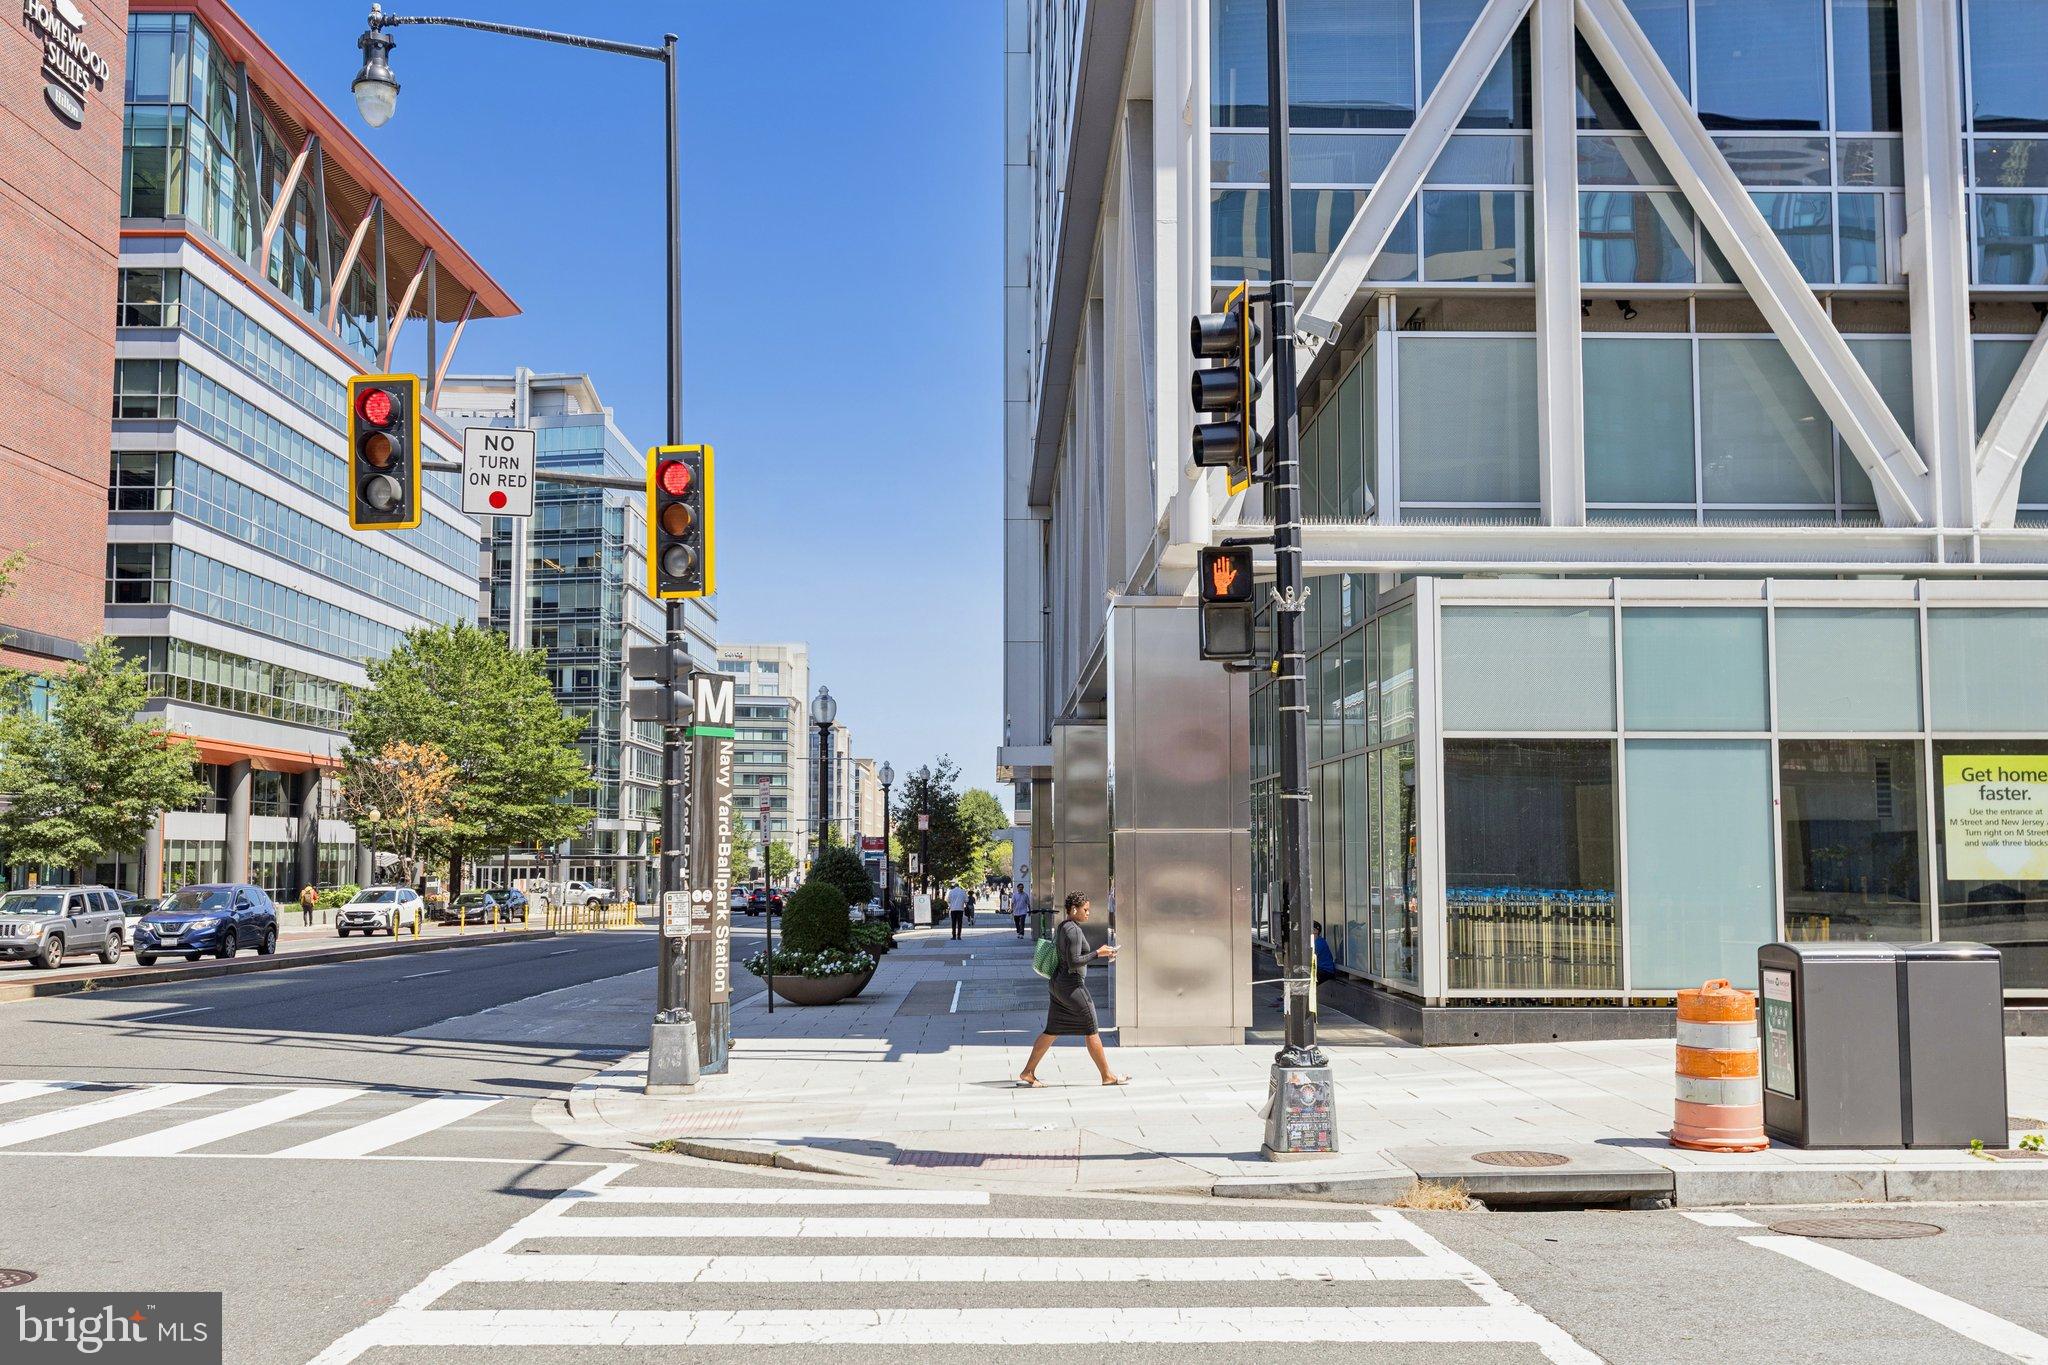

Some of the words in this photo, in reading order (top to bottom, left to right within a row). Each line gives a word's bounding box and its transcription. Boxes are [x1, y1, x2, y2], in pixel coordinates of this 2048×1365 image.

[24, 0, 109, 81] HOMEWOOD
[47, 41, 90, 92] SUITES
[55, 89, 79, 118] Hilton
[485, 434, 515, 452] NO
[479, 455, 519, 470] TURN
[469, 472, 490, 487] ON
[497, 473, 527, 488] RED
[698, 678, 734, 725] M
[716, 741, 734, 788] Navy
[1961, 767, 1993, 782] Get
[1998, 766, 2048, 782] home
[1979, 784, 2032, 801] faster.
[1969, 808, 1984, 816] Use
[1985, 808, 1998, 816] the
[1960, 818, 1983, 826] Street
[2021, 819, 2045, 828] Jersey
[1984, 829, 2002, 838] right
[714, 792, 733, 921] Yard-Ballpark
[1020, 864, 1029, 879] 9
[714, 925, 730, 993] Station
